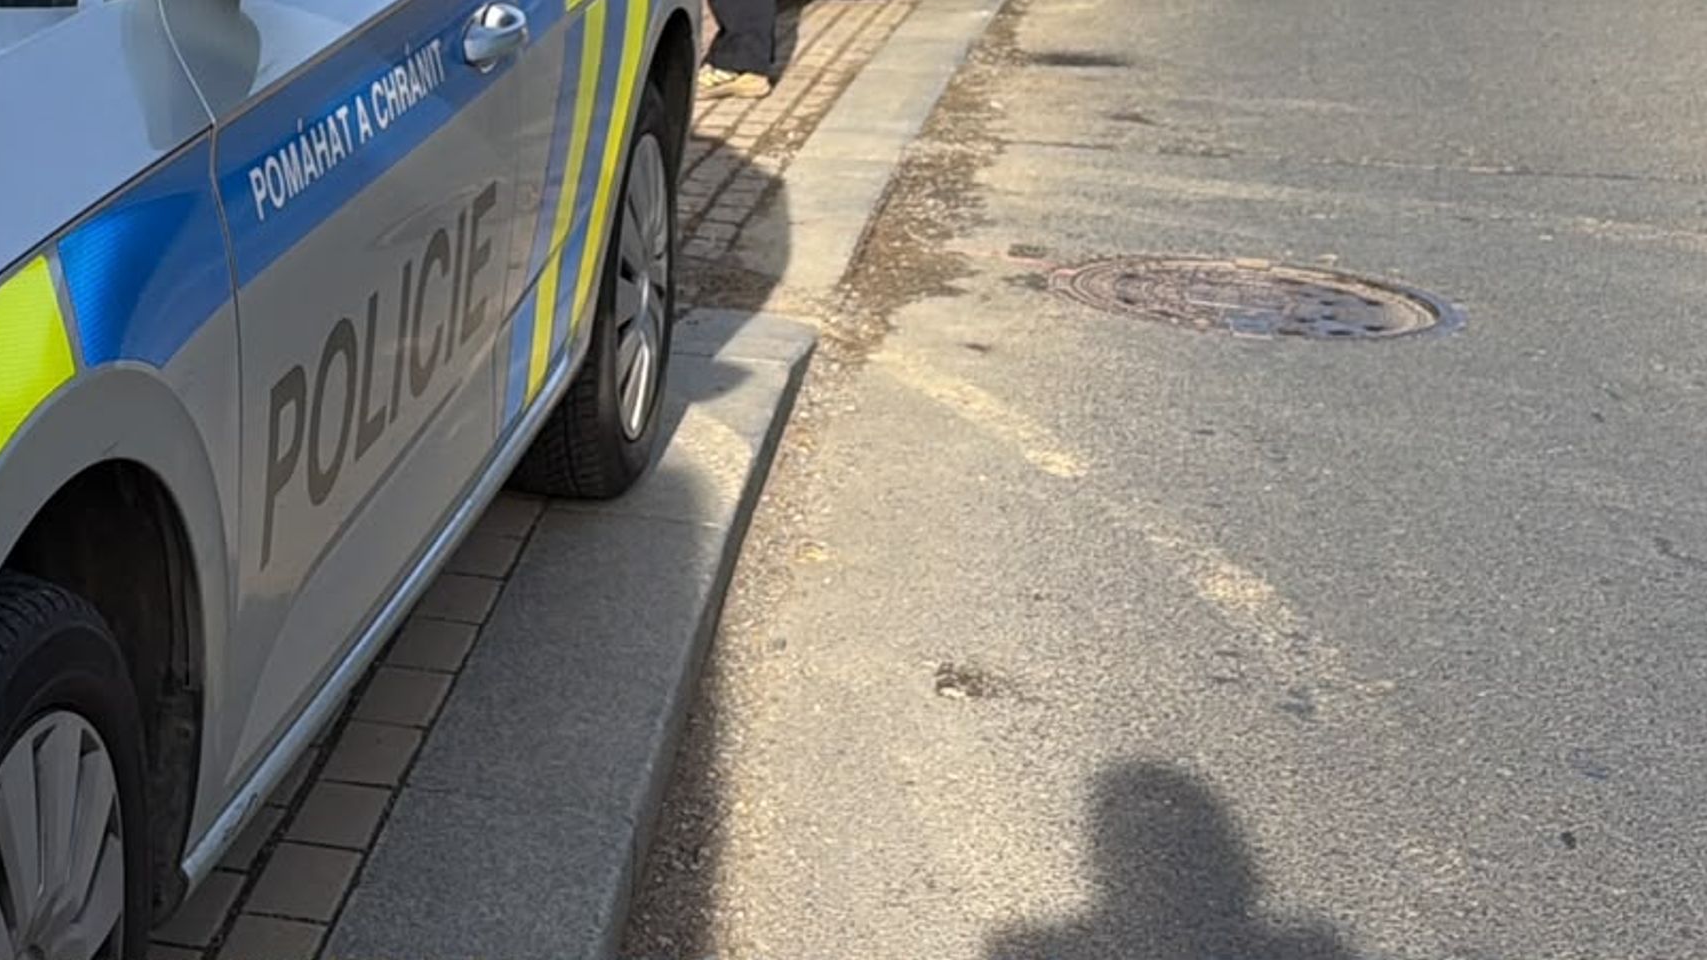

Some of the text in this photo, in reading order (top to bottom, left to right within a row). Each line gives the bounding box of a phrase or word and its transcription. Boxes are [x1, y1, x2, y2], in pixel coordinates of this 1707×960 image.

[248, 39, 445, 221] POMÁHAT A CHRÁNIT
[260, 180, 497, 571] POLICIE
